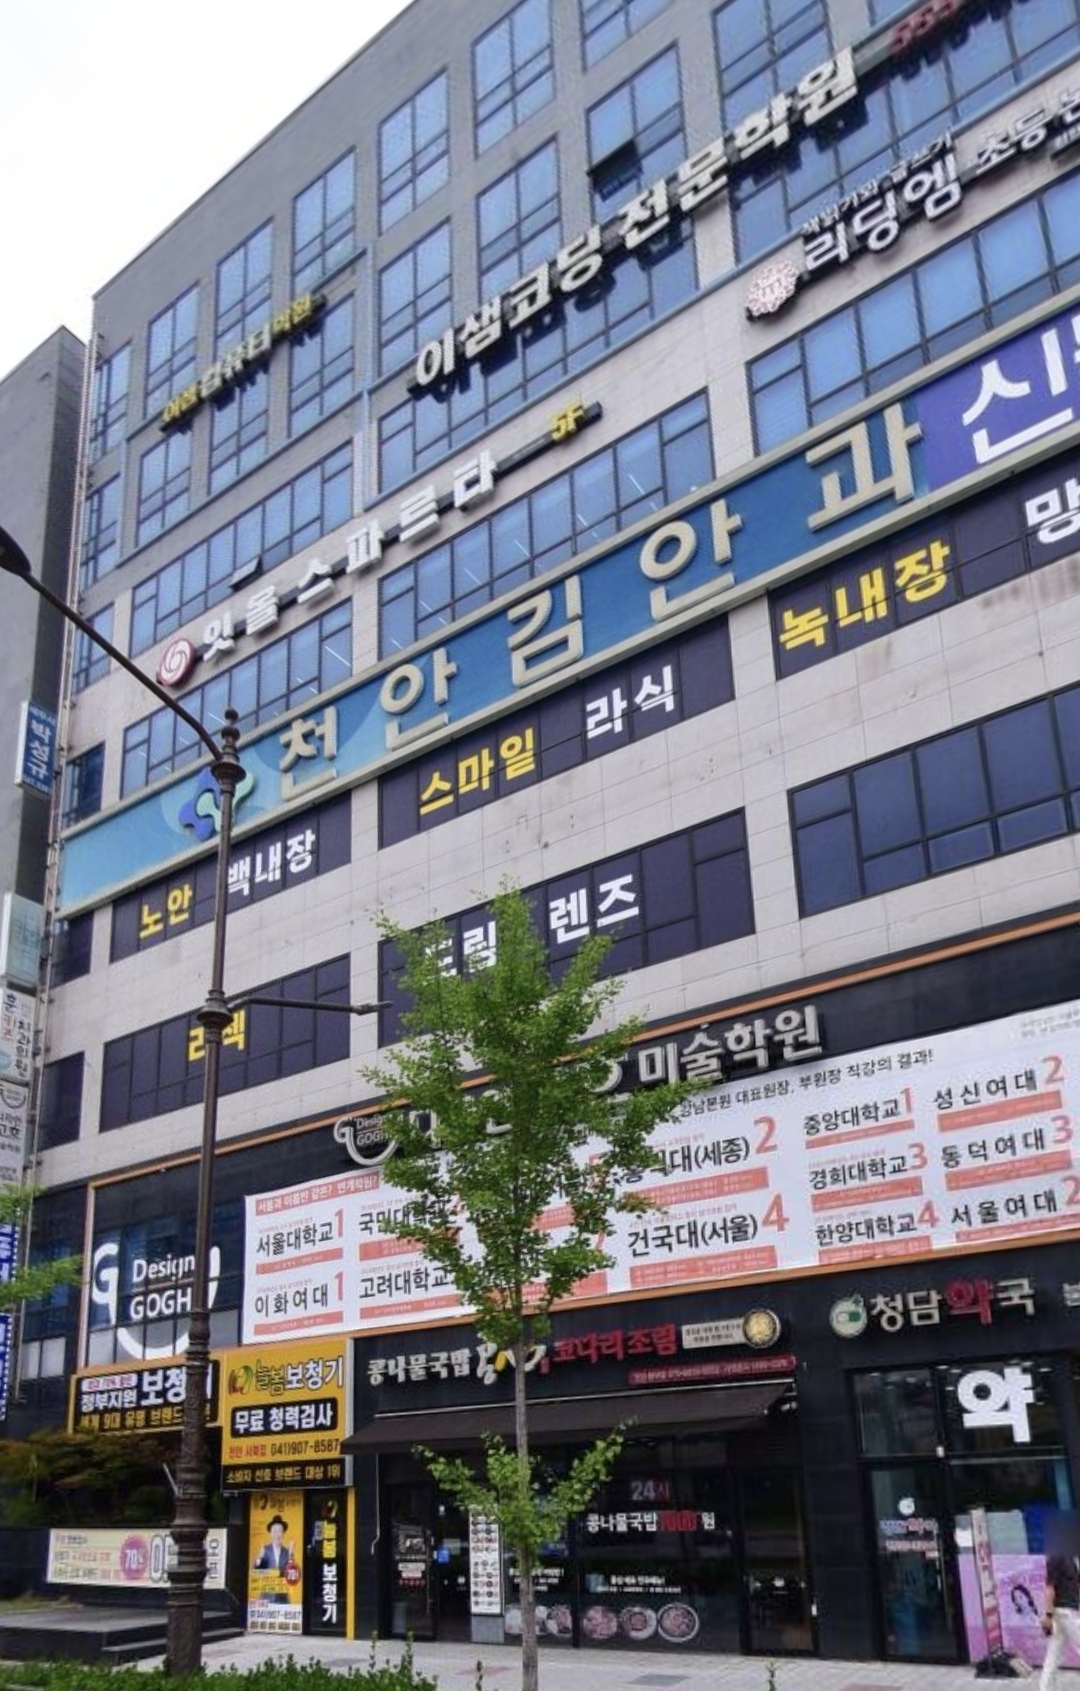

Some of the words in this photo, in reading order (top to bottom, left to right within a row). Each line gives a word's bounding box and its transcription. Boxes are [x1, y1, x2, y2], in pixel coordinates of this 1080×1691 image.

[803, 153, 963, 271] 리딩엠
[962, 318, 1080, 465] 신
[549, 401, 589, 442] 5F
[779, 540, 952, 651] 녹내장
[419, 727, 536, 816] 스마일
[586, 665, 675, 740] 라식
[139, 883, 193, 939] 노안
[227, 829, 316, 896] 백내장
[549, 874, 640, 945] 렌즈
[638, 1004, 823, 1086] 미술학원
[799, 1069, 842, 1090] 부원장
[847, 1056, 892, 1079] 직강의
[932, 1068, 1038, 1111] 성신여대
[1042, 1055, 1066, 1085] 2
[356, 1113, 385, 1130] Desig
[752, 1115, 779, 1155] 2
[803, 1098, 900, 1137] 중앙대학교
[900, 1087, 913, 1115] 1
[941, 1128, 1046, 1169] 동덕여대
[1050, 1115, 1074, 1144] 3
[808, 1155, 908, 1191] 경희대학교
[908, 1142, 928, 1170] 3
[814, 1213, 918, 1248] 한양대학교
[917, 1200, 940, 1229] 4
[951, 1188, 1058, 1227] 서울여대
[1060, 1175, 1080, 1207] 2
[257, 1220, 334, 1257] 서울대학교
[334, 1208, 345, 1239] 1
[627, 1214, 759, 1258] 건국대(서울)
[760, 1193, 791, 1233] 4
[132, 1253, 196, 1283] Design
[359, 1266, 452, 1299] 고려대학교
[129, 1286, 193, 1321] GOGH
[254, 1283, 328, 1316] 이화여대
[334, 1271, 345, 1302] 1
[869, 1274, 1036, 1333] 청담약국
[140, 1362, 213, 1407] 보청
[367, 1347, 473, 1387] 콩나물국밥
[81, 1388, 138, 1413] 정부지원
[150, 1406, 183, 1426] 브랜드
[234, 1408, 265, 1435] 무료
[269, 1402, 334, 1432] 청력검사
[957, 1364, 1036, 1443] 약
[305, 1465, 324, 1480] 대상
[586, 1510, 658, 1533] 콩나물국밥
